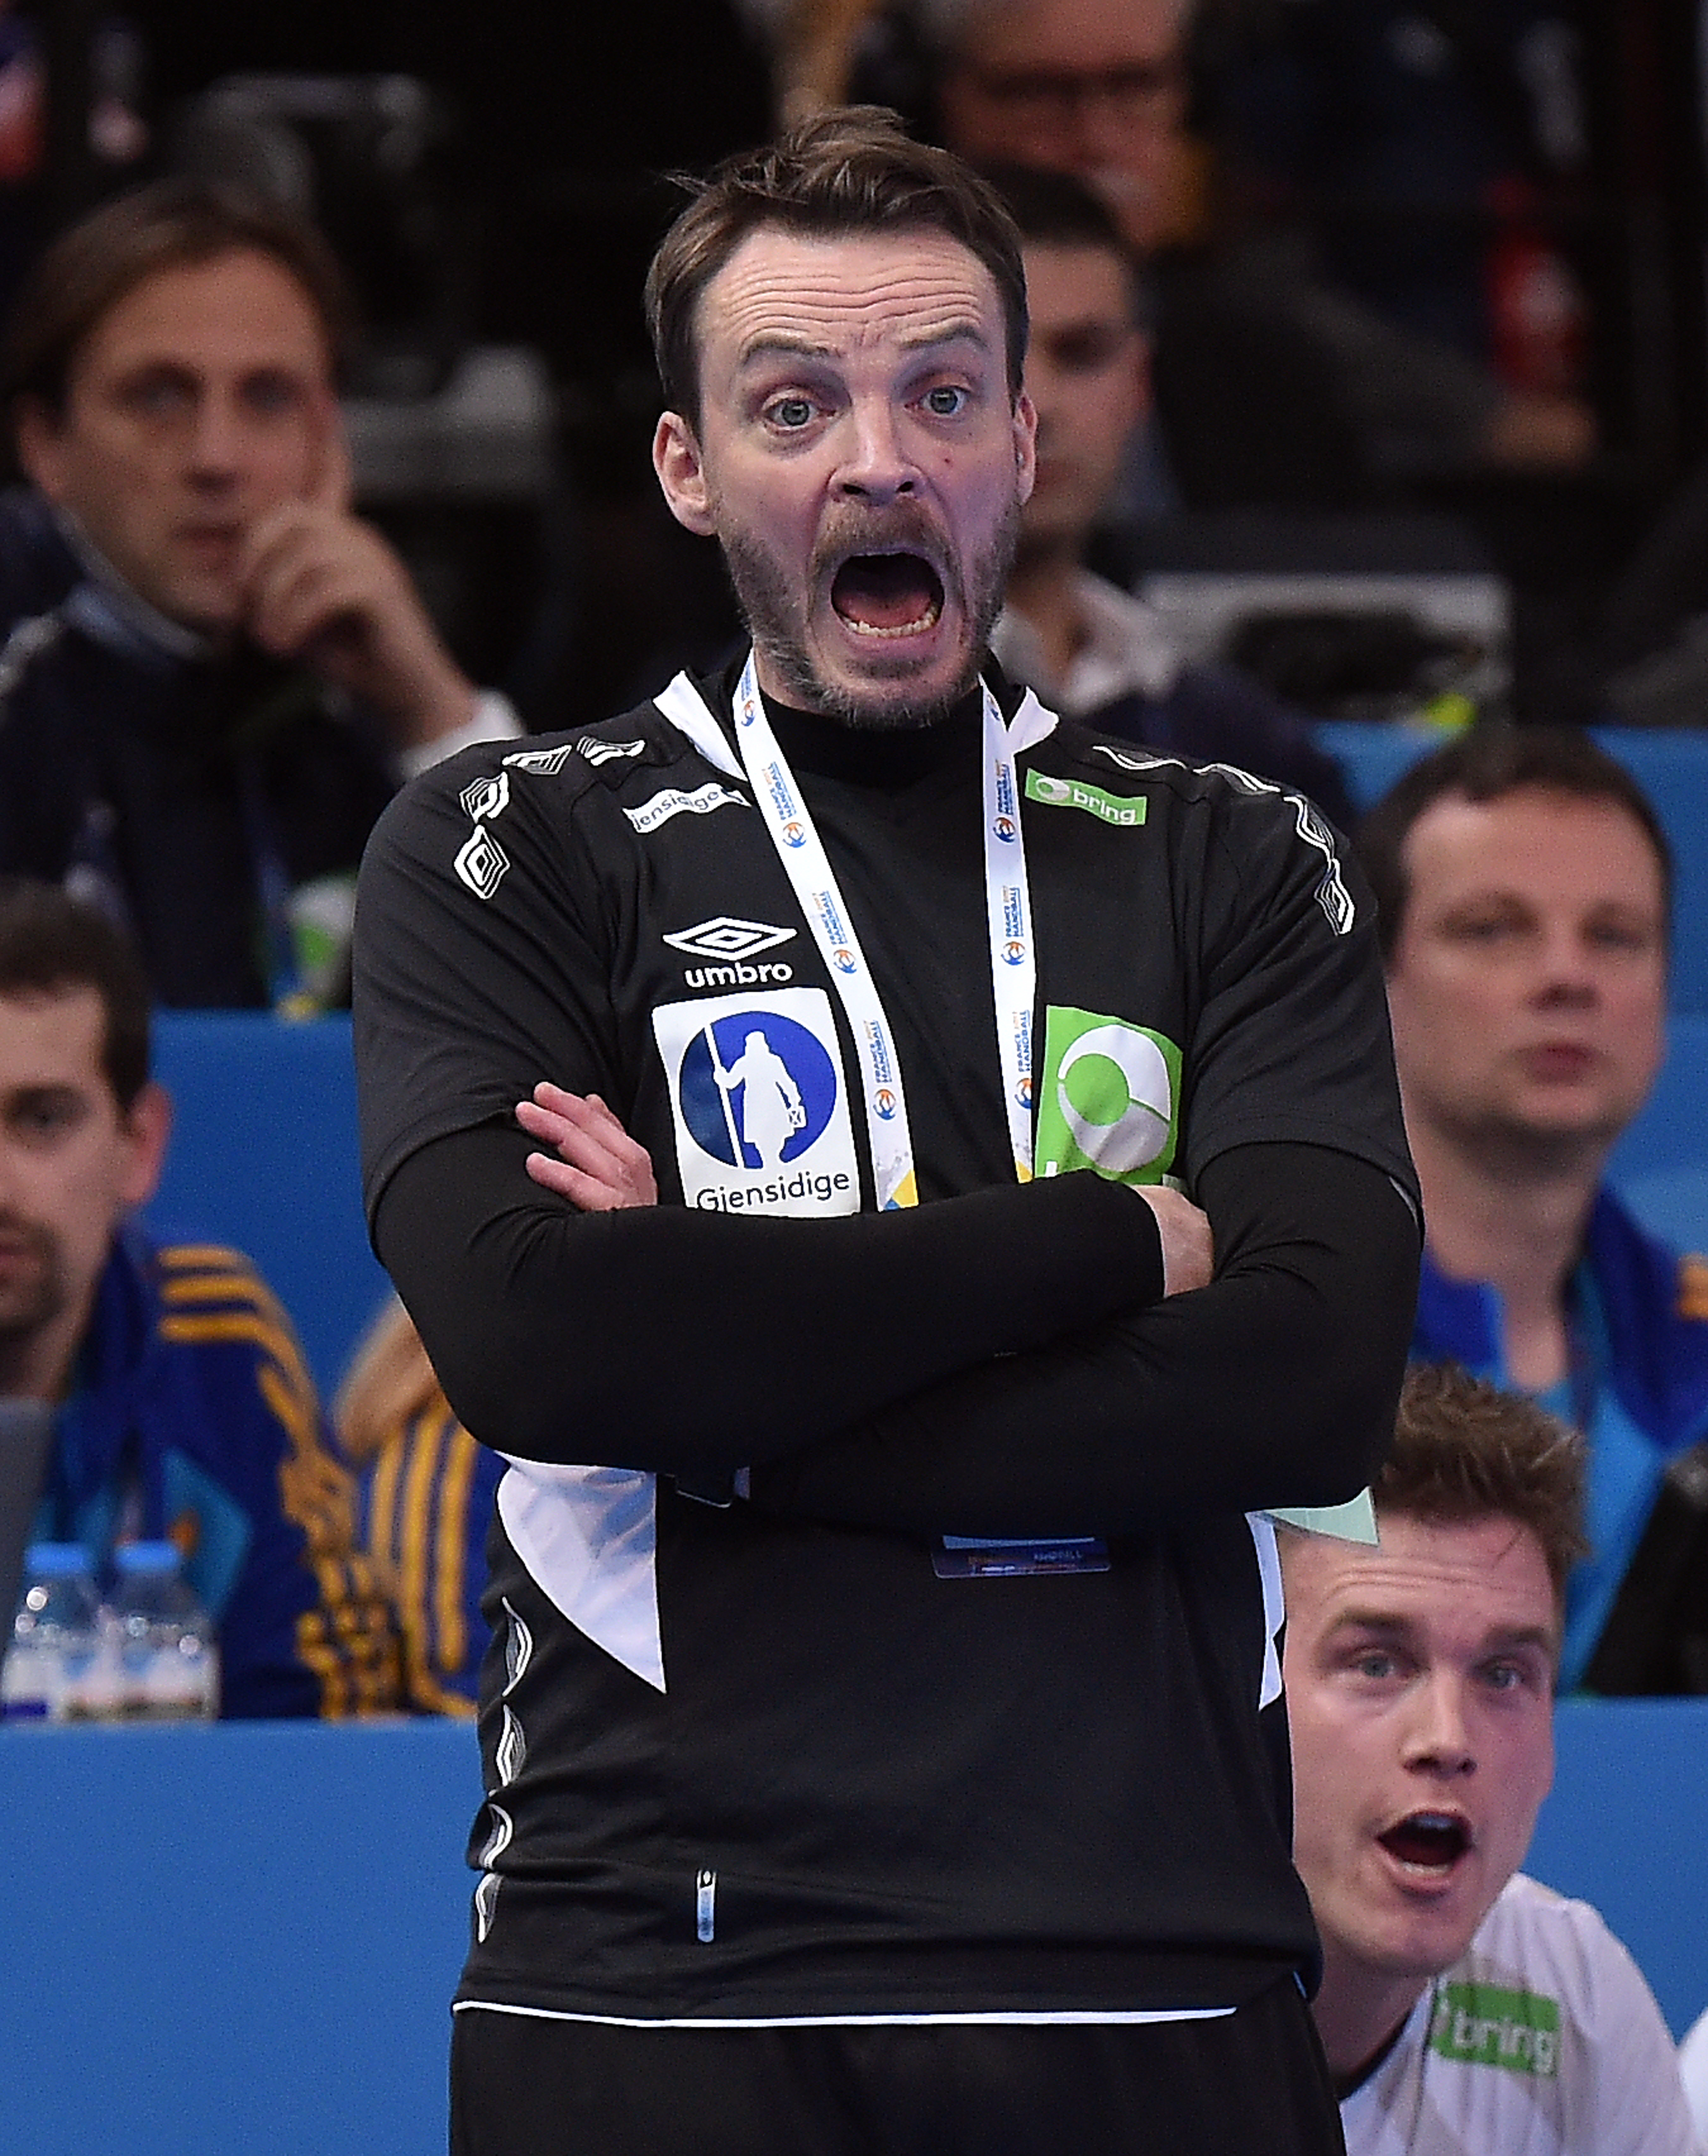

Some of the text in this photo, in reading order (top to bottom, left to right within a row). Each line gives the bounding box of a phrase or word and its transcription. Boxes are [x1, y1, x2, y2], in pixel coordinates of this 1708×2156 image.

[1073, 789, 1136, 825] bring
[685, 962, 793, 987] umbro
[1020, 1011, 1030, 1072] HANDBALL
[1454, 2009, 1554, 2074] bring
